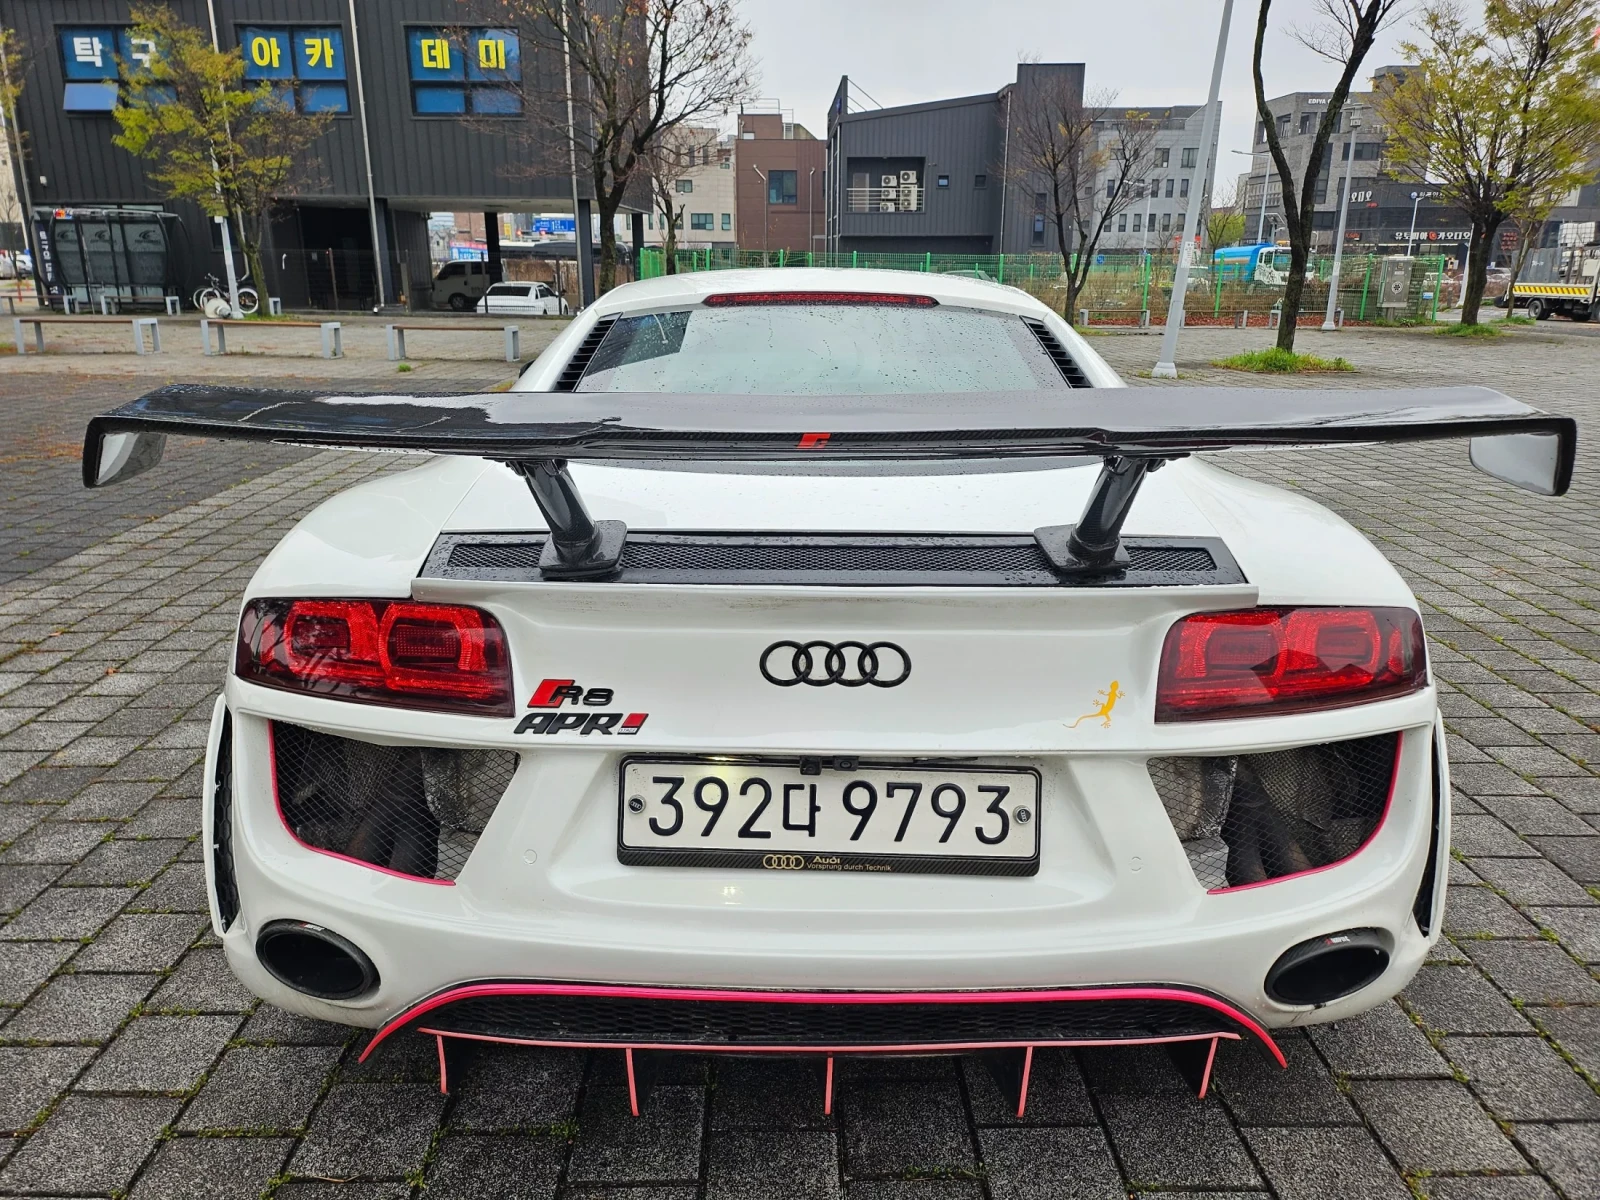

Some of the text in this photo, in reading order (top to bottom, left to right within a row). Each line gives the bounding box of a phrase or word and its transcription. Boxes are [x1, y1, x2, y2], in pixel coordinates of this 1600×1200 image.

[73, 37, 156, 68] 탁구
[1437, 231, 1471, 240] 카오디오
[547, 685, 614, 706] R8
[513, 712, 623, 735] APR
[842, 779, 1010, 845] 9793
[806, 862, 841, 870] Vorsprung
[812, 855, 841, 864] Audi
